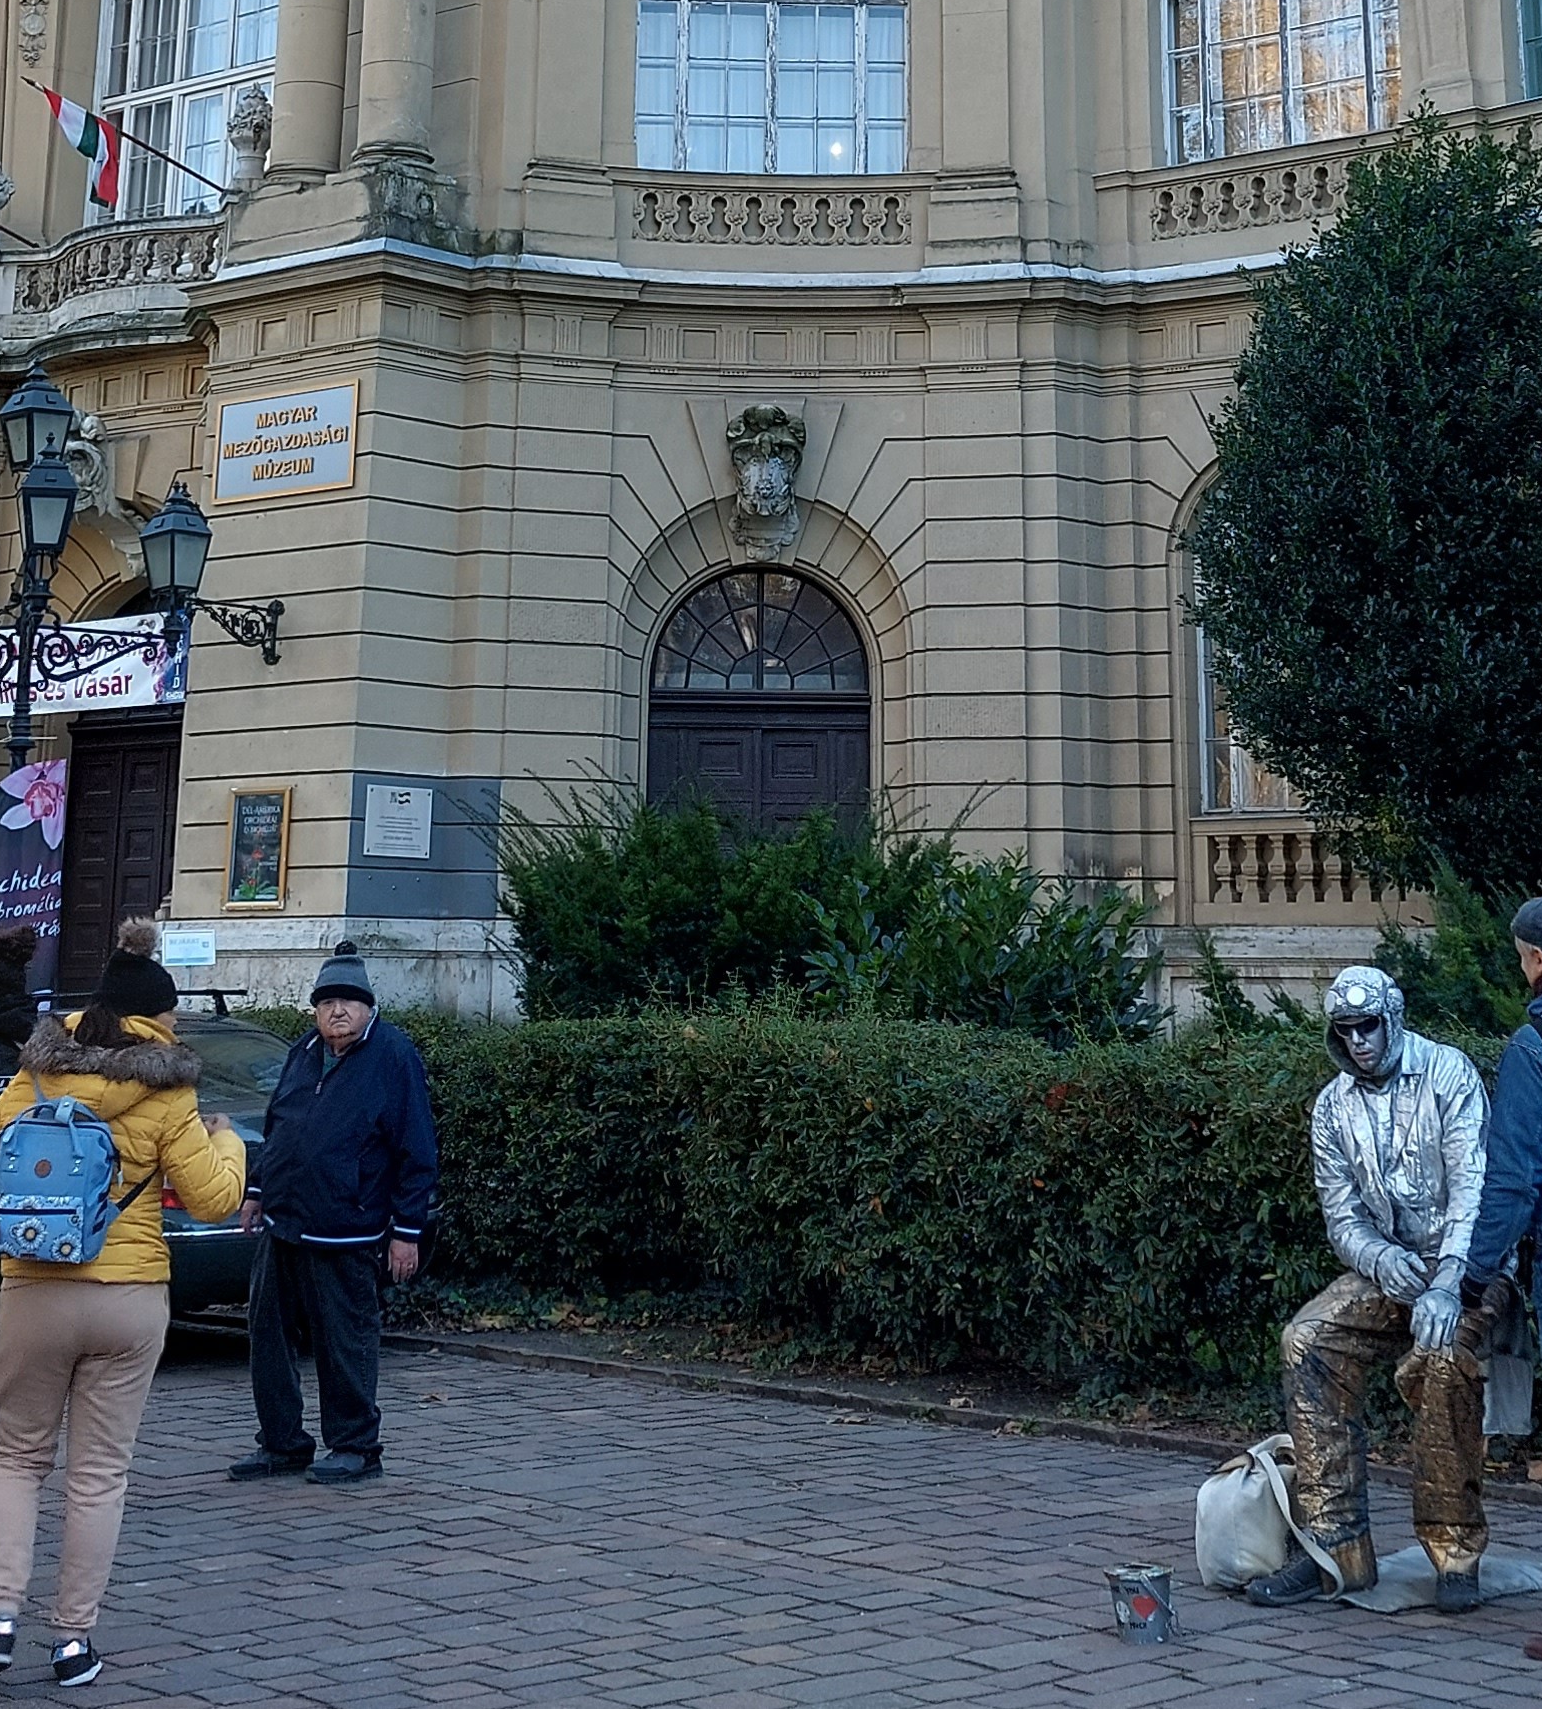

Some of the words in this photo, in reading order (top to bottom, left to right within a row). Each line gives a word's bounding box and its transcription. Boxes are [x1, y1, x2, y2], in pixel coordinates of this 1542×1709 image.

[256, 405, 318, 429] MAGYAR
[223, 424, 349, 459] MEZŐGAZDASÁGI
[252, 457, 314, 481] MÚZEUM
[74, 667, 133, 699] Vásár
